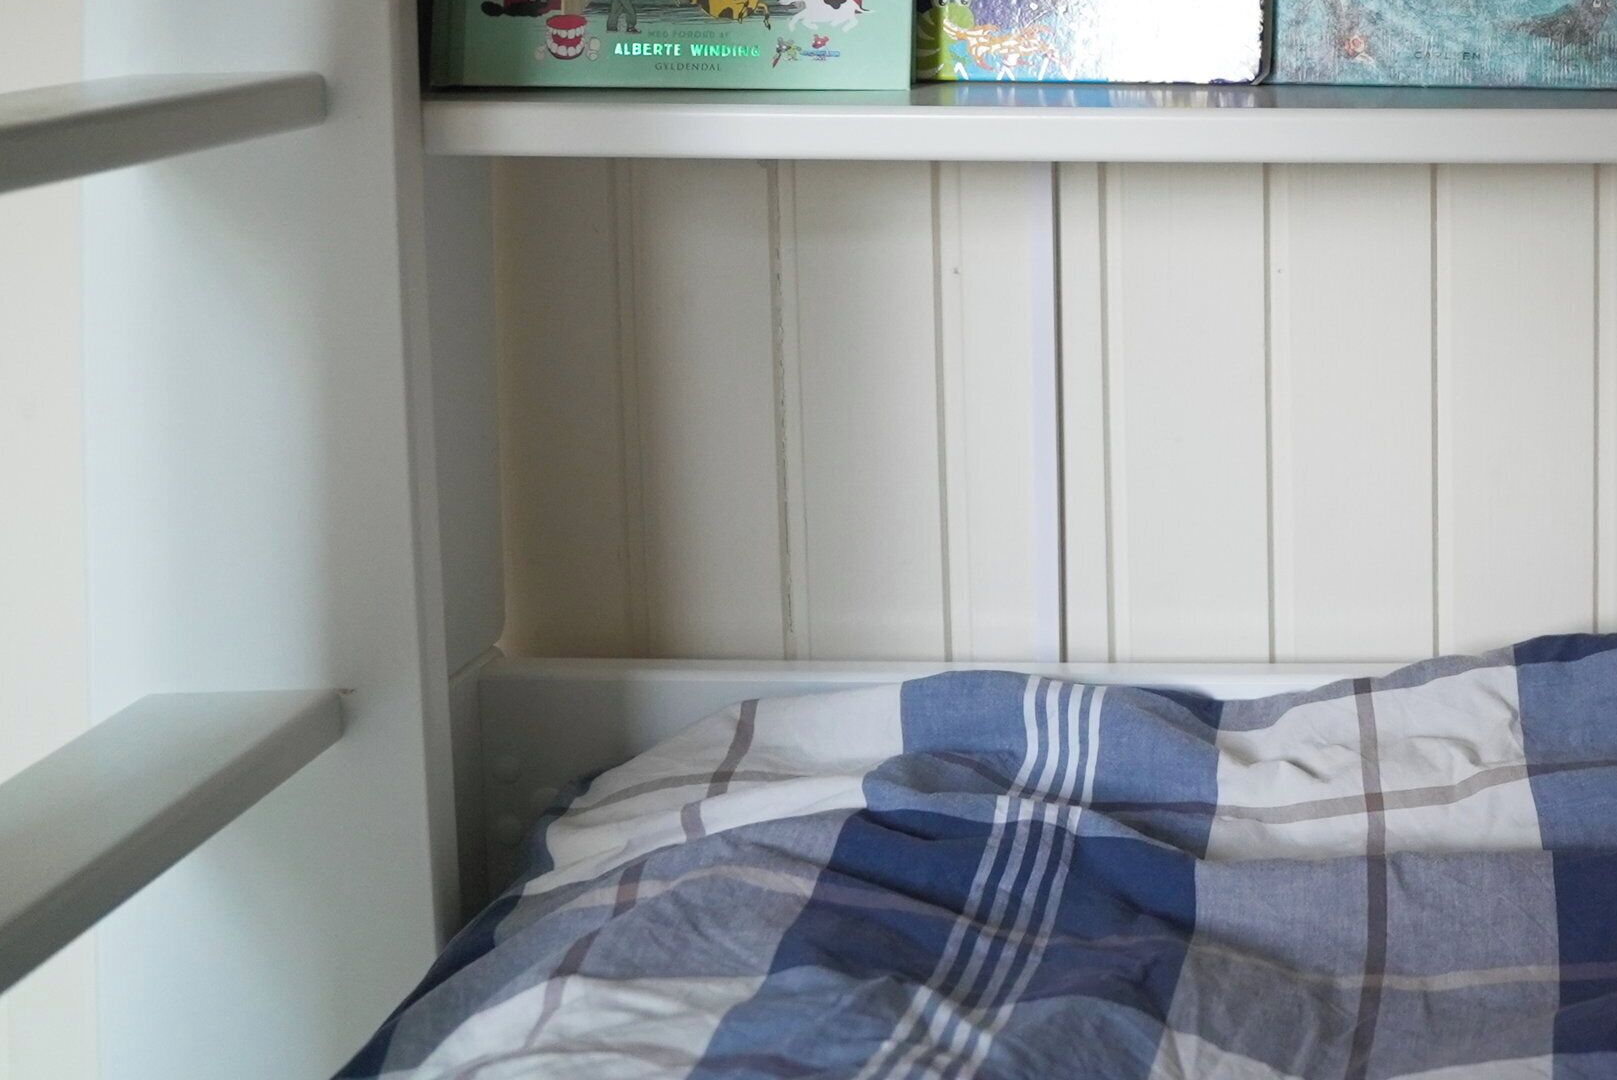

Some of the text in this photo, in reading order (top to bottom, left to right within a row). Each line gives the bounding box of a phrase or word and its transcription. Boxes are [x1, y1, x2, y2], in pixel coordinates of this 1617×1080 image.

[614, 42, 761, 57] ALBERTE WINDING
[654, 62, 721, 71] GYLDENDAL
